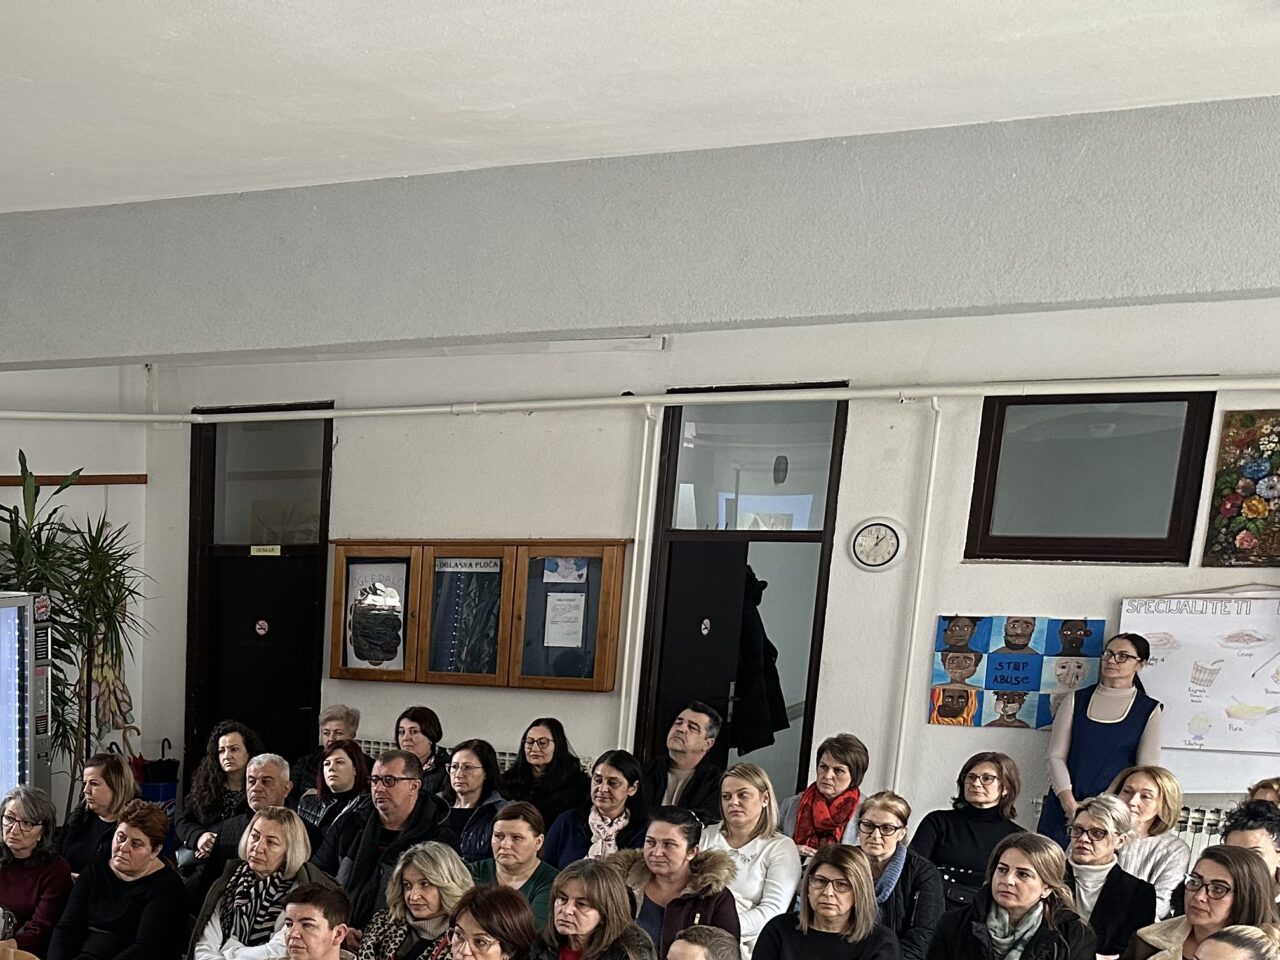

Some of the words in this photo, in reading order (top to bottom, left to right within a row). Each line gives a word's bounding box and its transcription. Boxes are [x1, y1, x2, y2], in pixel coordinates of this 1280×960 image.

[439, 561, 473, 569] OGLASNA
[475, 560, 498, 568] PLOČA
[1126, 599, 1252, 615] SPECIJALITETI
